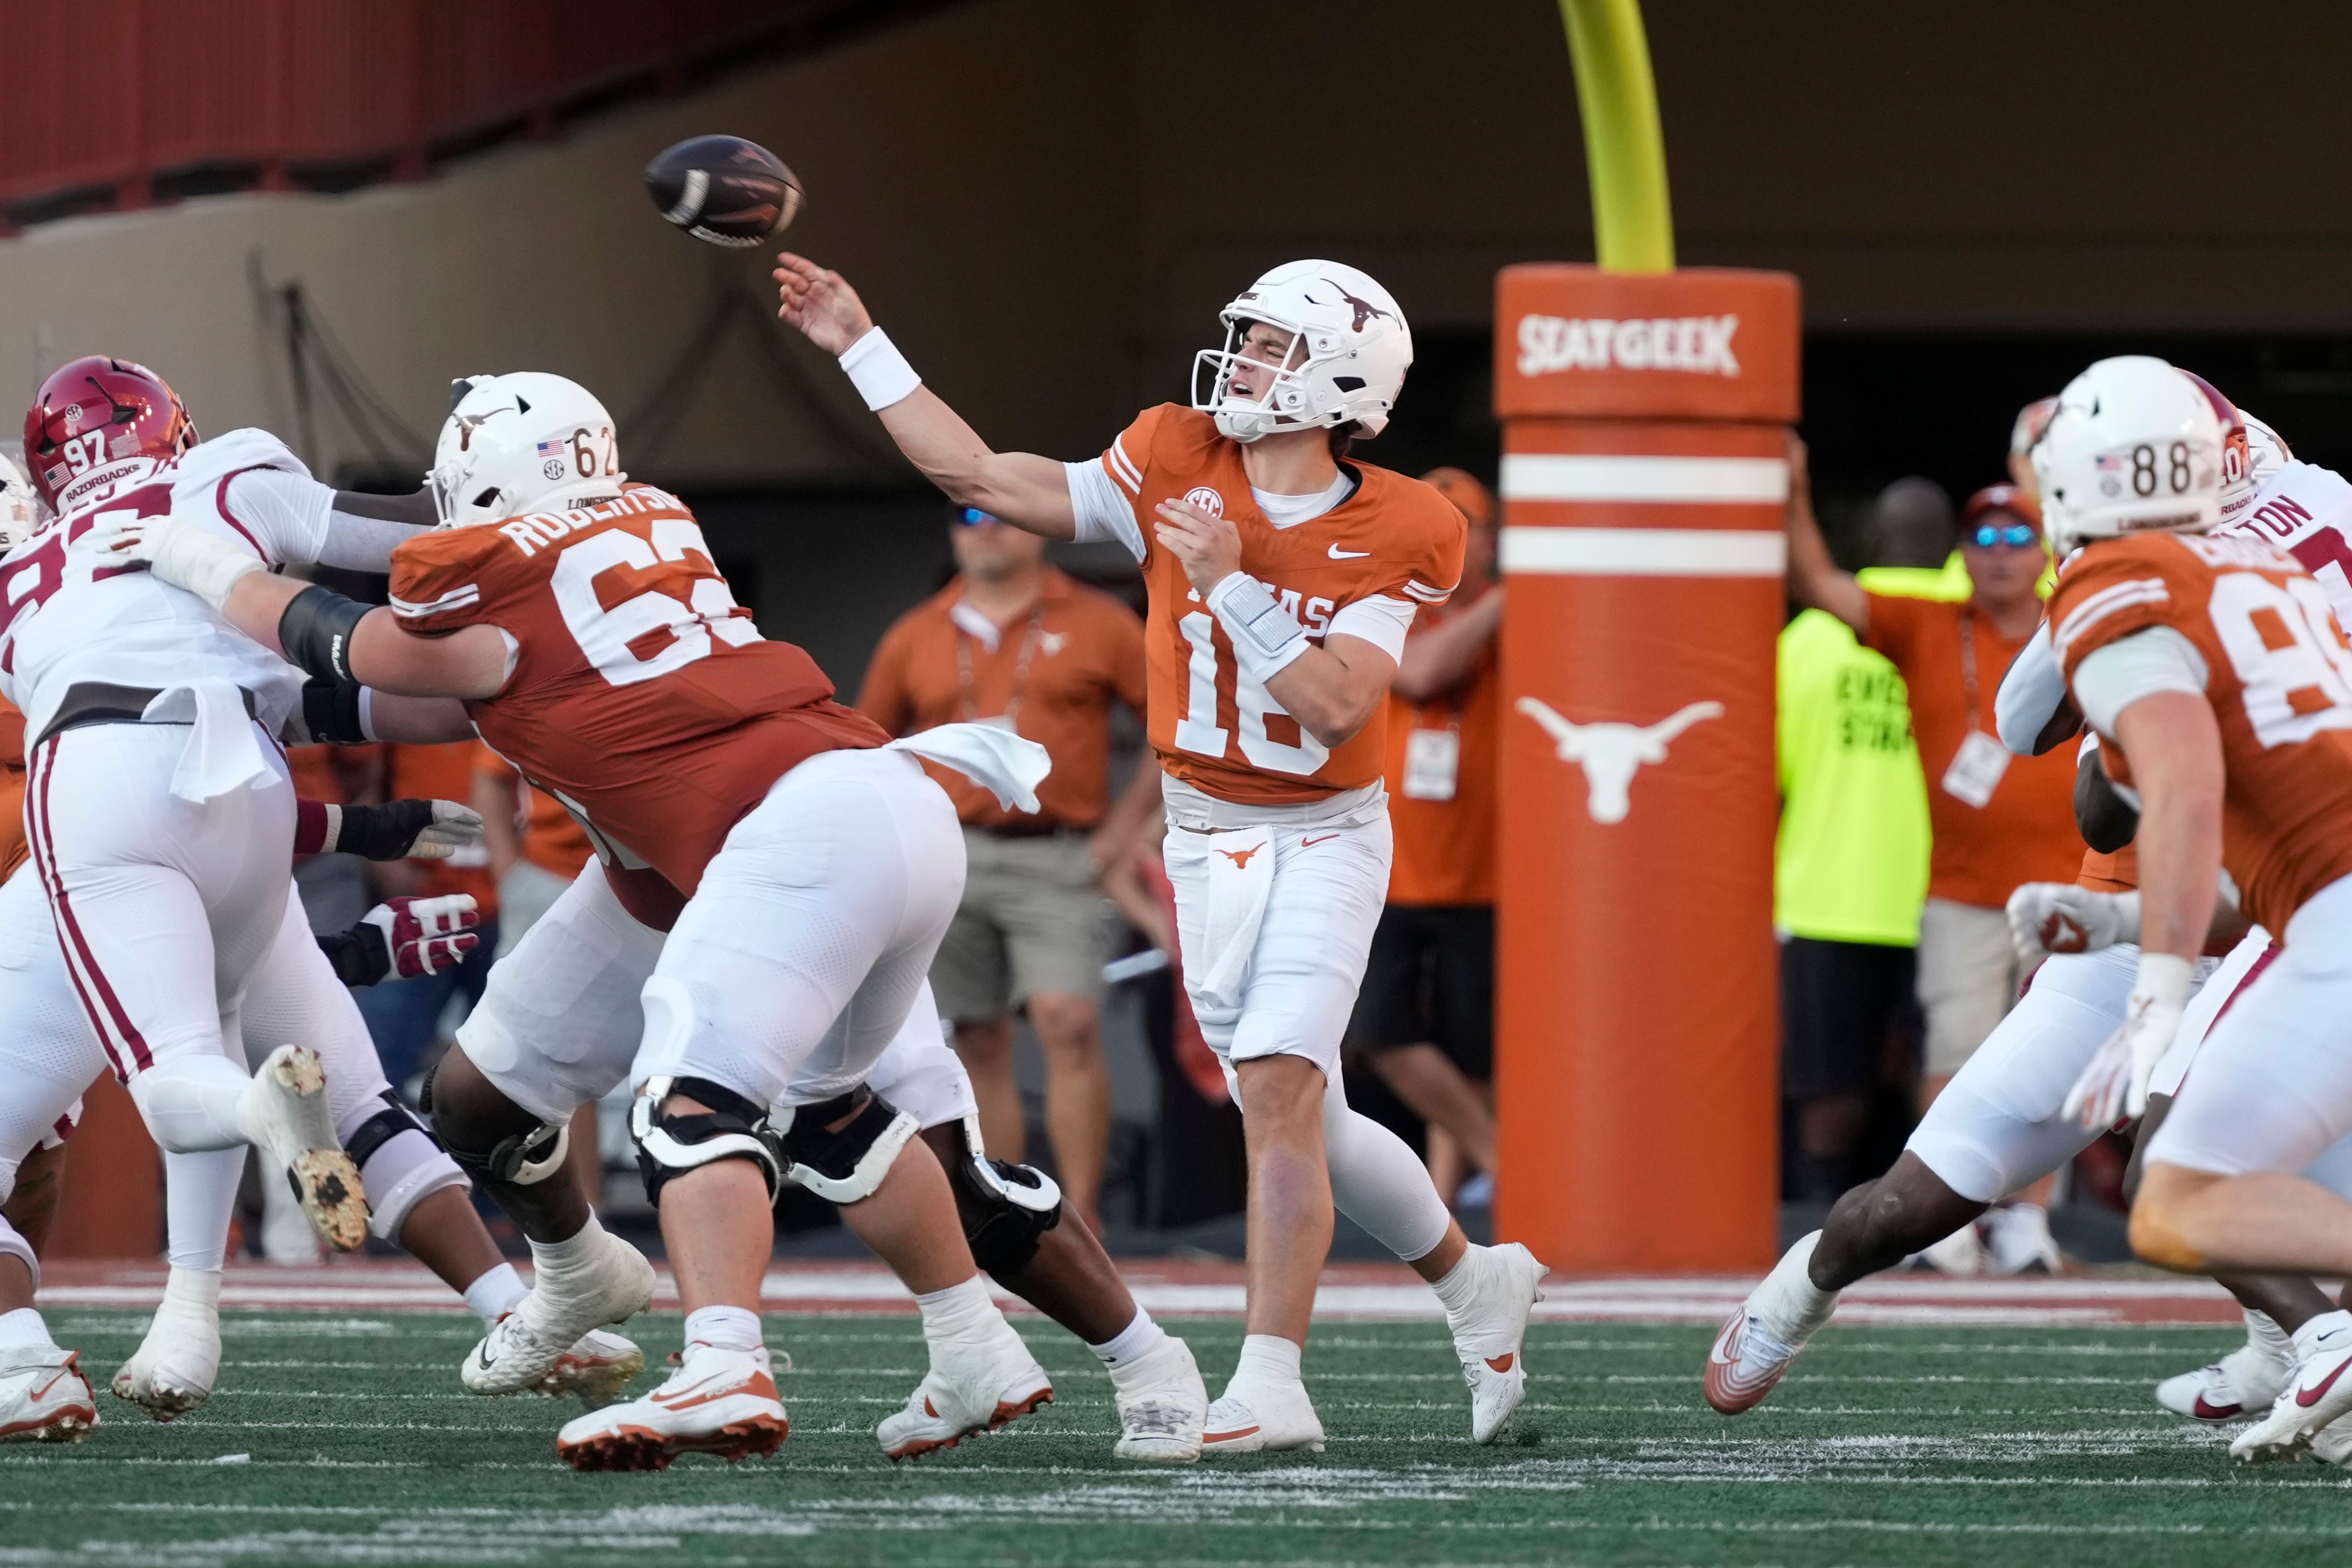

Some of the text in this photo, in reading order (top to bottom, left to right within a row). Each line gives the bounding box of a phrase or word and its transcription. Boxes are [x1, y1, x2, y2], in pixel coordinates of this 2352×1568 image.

[1516, 313, 1741, 379] SEATGEEK
[66, 404, 83, 421] SEC
[63, 429, 107, 476] 97
[544, 460, 564, 479] SEC
[2132, 441, 2191, 498] 88
[2221, 446, 2242, 484] 0
[65, 463, 141, 503] RAZORBACKS
[1175, 610, 1330, 775] 16
